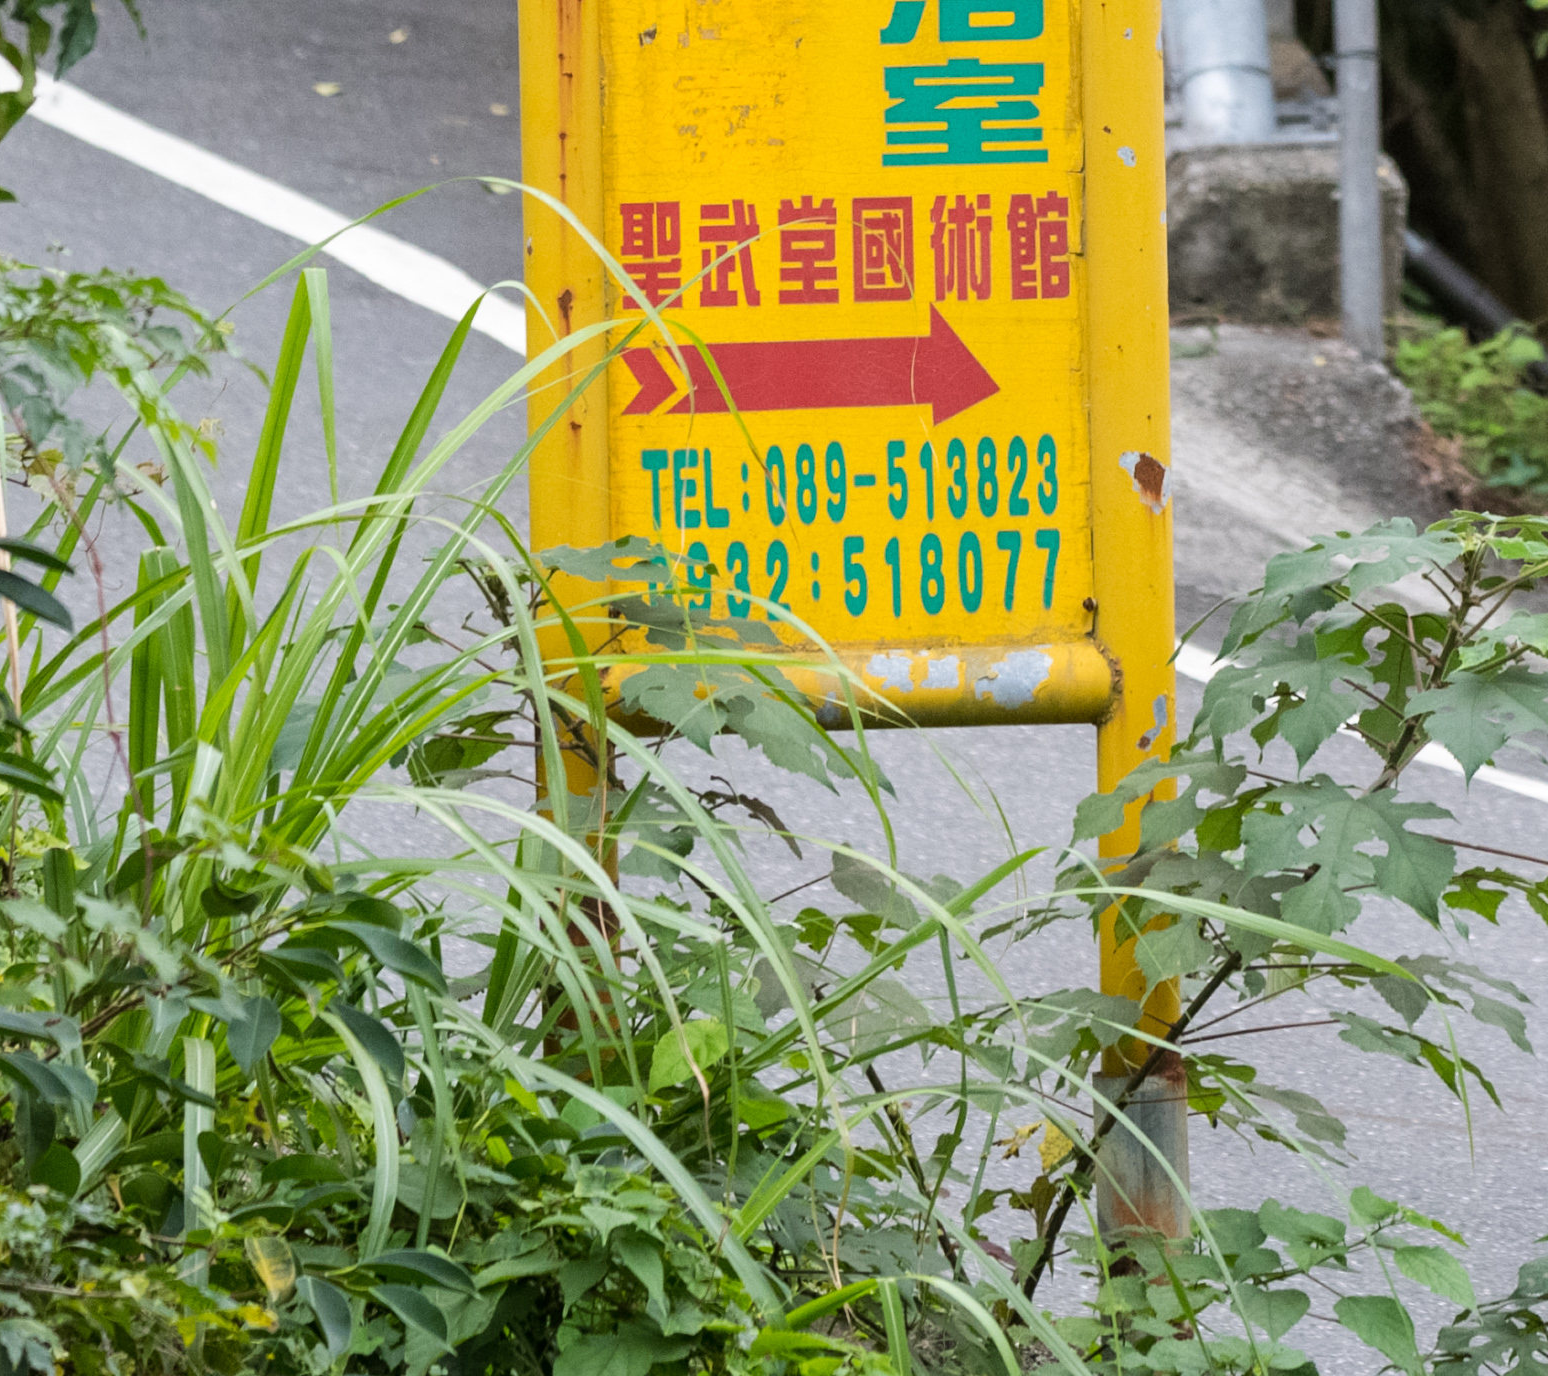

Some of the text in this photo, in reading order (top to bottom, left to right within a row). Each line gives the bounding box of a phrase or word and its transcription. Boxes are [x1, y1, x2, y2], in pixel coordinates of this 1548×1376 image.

[619, 190, 1072, 311] 聖武堂國術館
[641, 433, 1058, 530] TEL:089-513823
